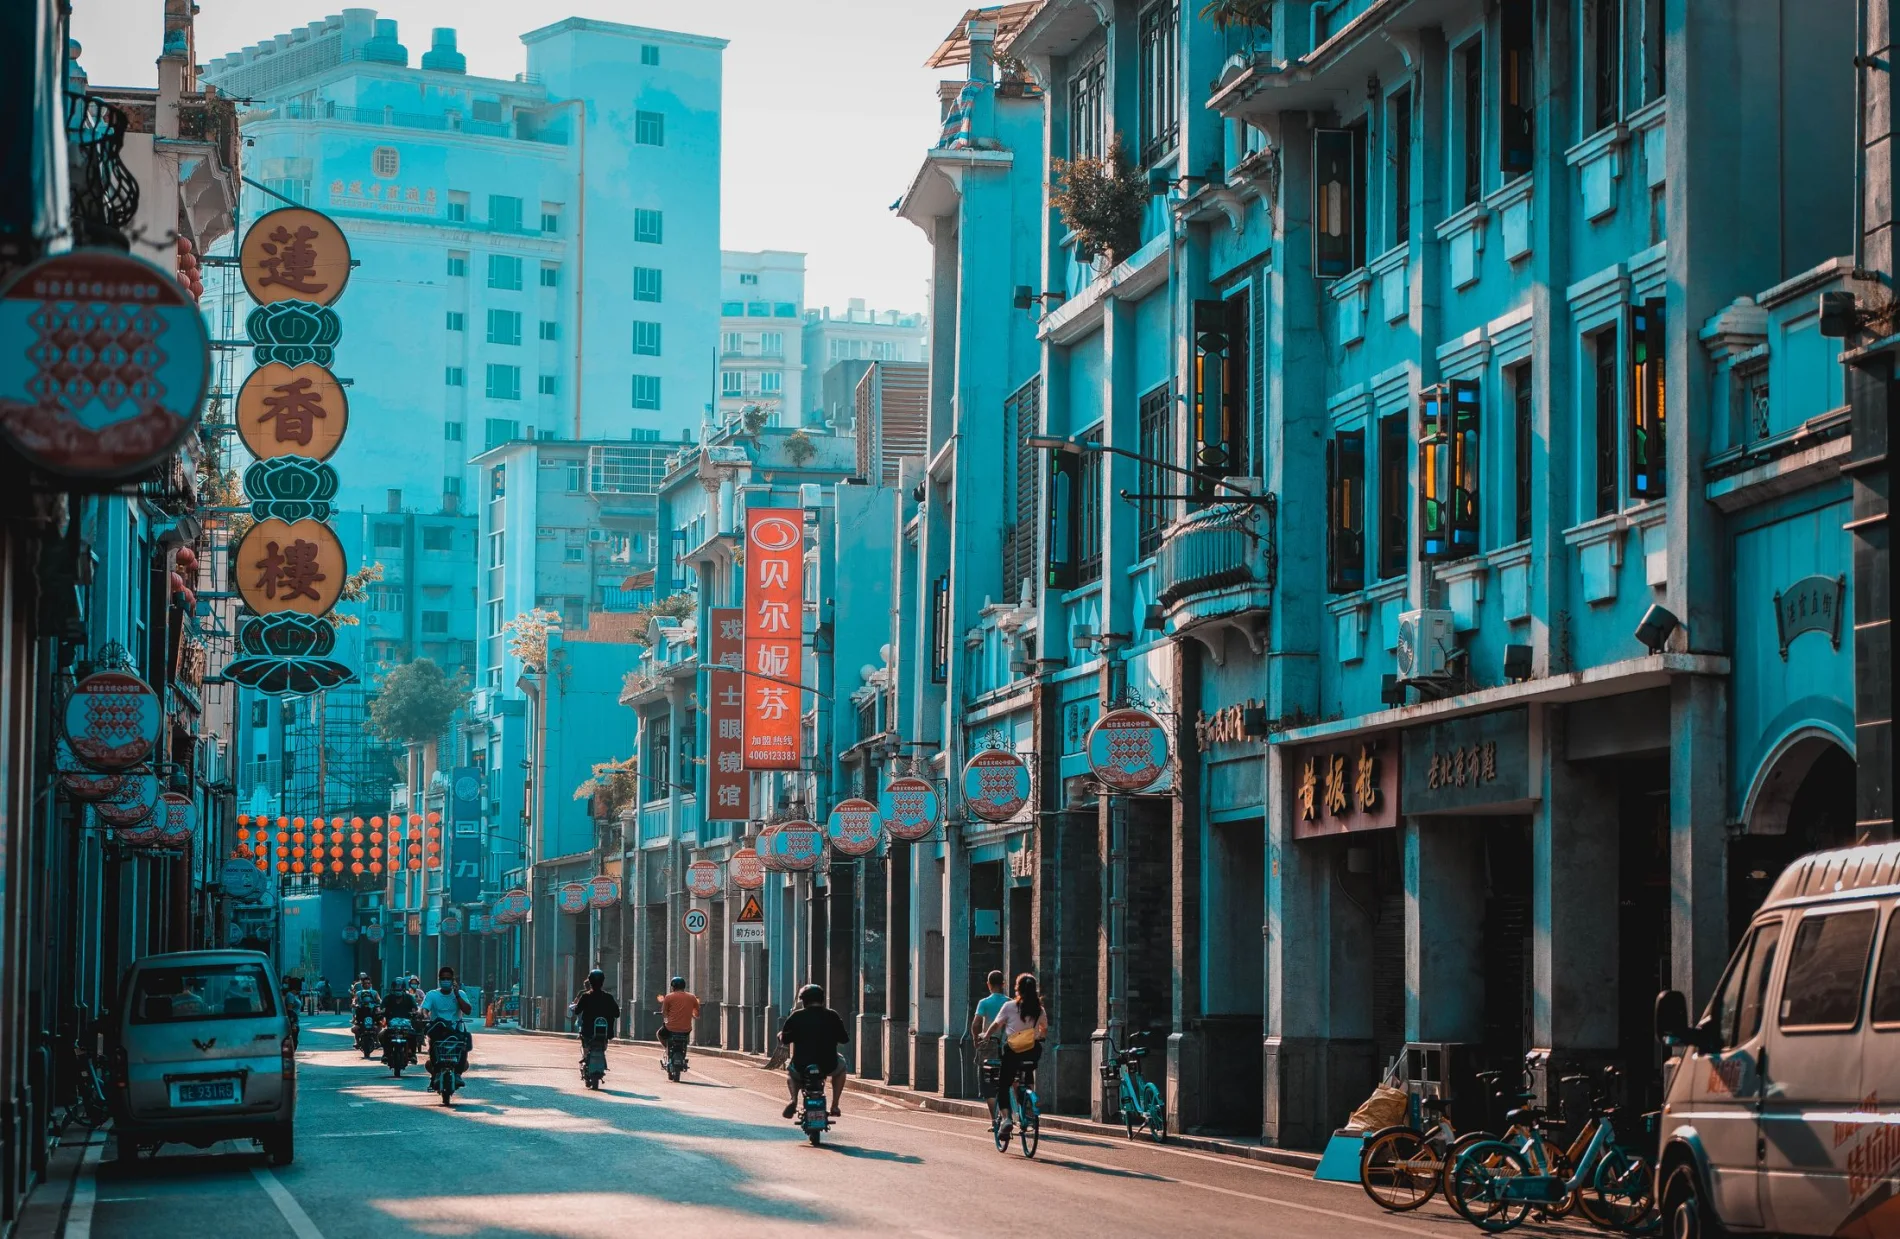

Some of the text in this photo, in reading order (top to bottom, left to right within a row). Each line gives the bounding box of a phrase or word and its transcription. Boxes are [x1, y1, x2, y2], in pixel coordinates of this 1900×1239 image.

[757, 559, 791, 720] 贝尔妮芬
[749, 751, 796, 761] 4006123383
[751, 736, 794, 746] 加盟热线
[1428, 741, 1496, 789] 老北京布鞋
[455, 820, 480, 878] 回力
[688, 915, 705, 928] 20
